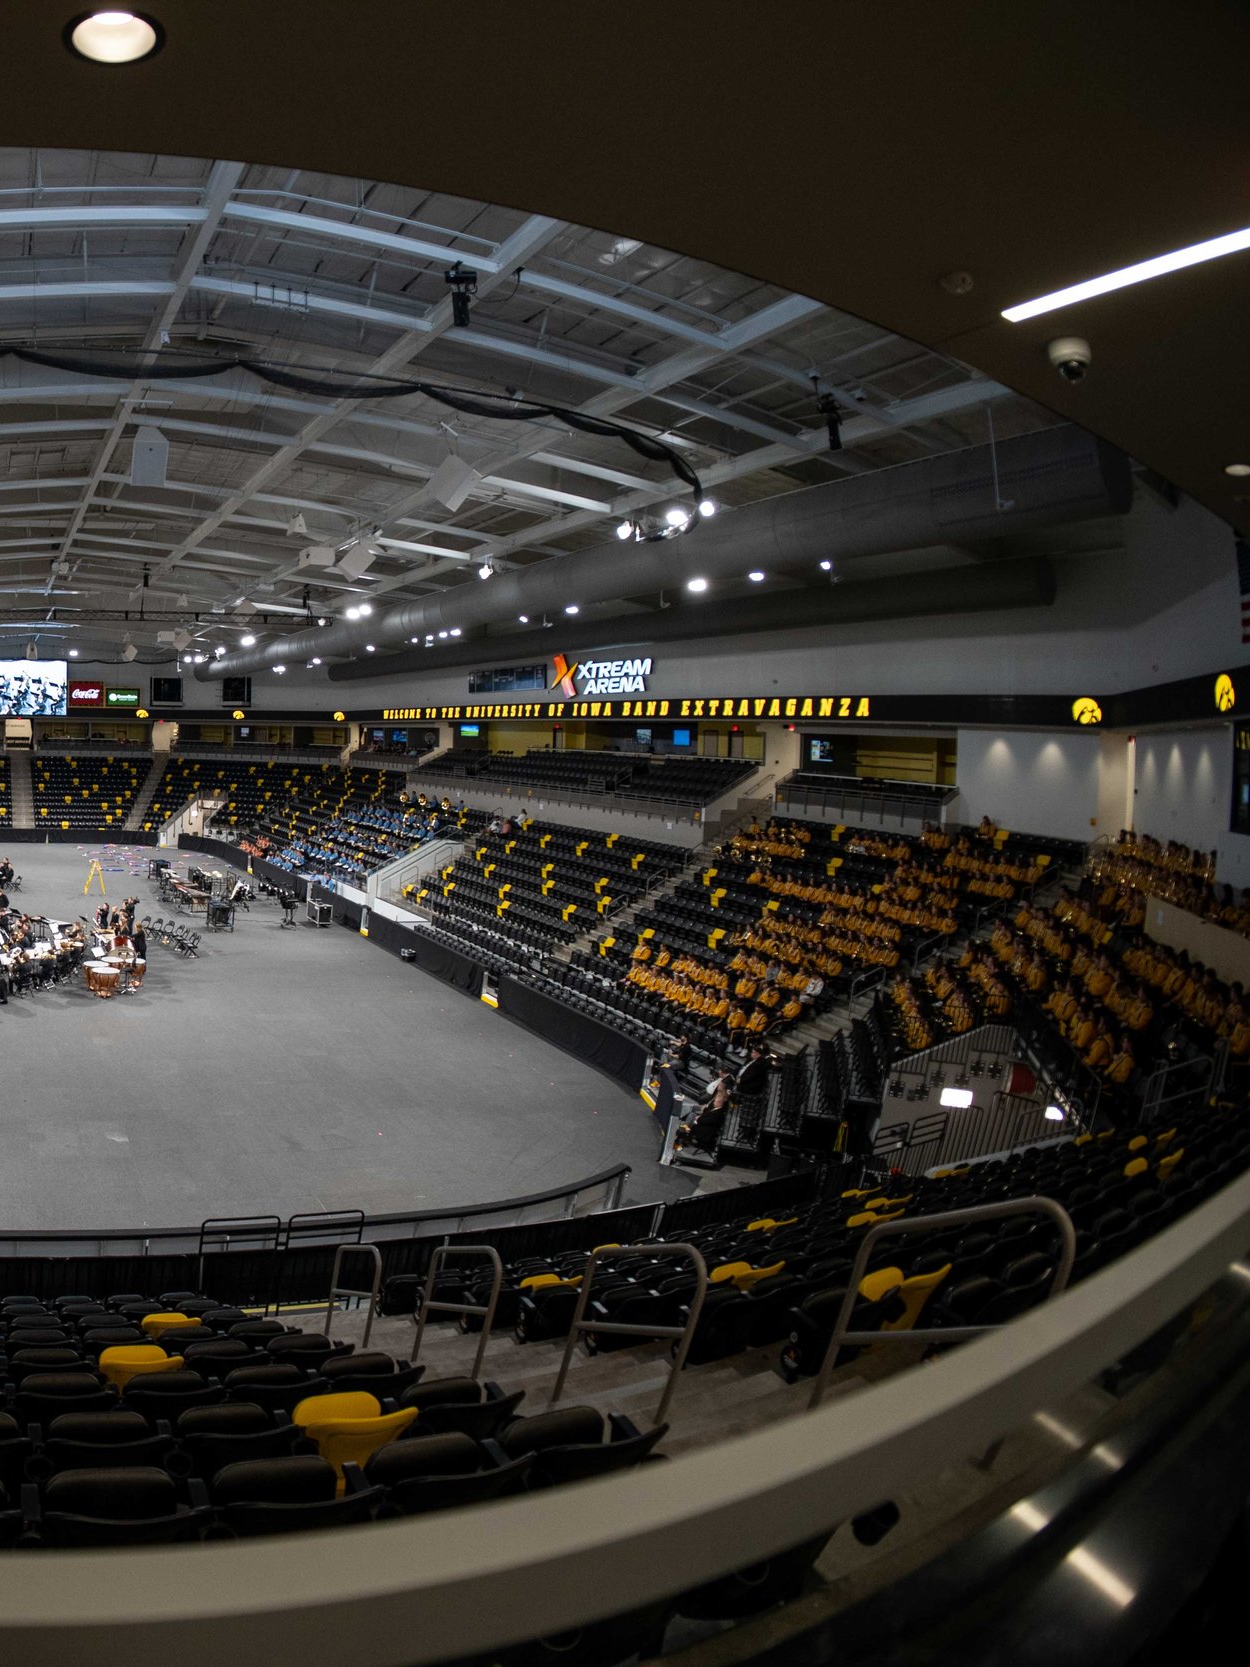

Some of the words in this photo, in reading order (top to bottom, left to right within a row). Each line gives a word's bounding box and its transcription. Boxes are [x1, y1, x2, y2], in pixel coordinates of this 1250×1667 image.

[577, 658, 652, 680] XTREAM
[583, 675, 646, 695] ARENA
[383, 708, 422, 720] WELCOME
[426, 708, 437, 719] TO
[442, 707, 460, 719] THE
[466, 703, 541, 719] UNIVERSITY
[548, 703, 565, 717] OF
[573, 702, 612, 717] IOWA
[622, 700, 670, 717] BAND
[681, 697, 871, 717] EXTRAVAGANZA
